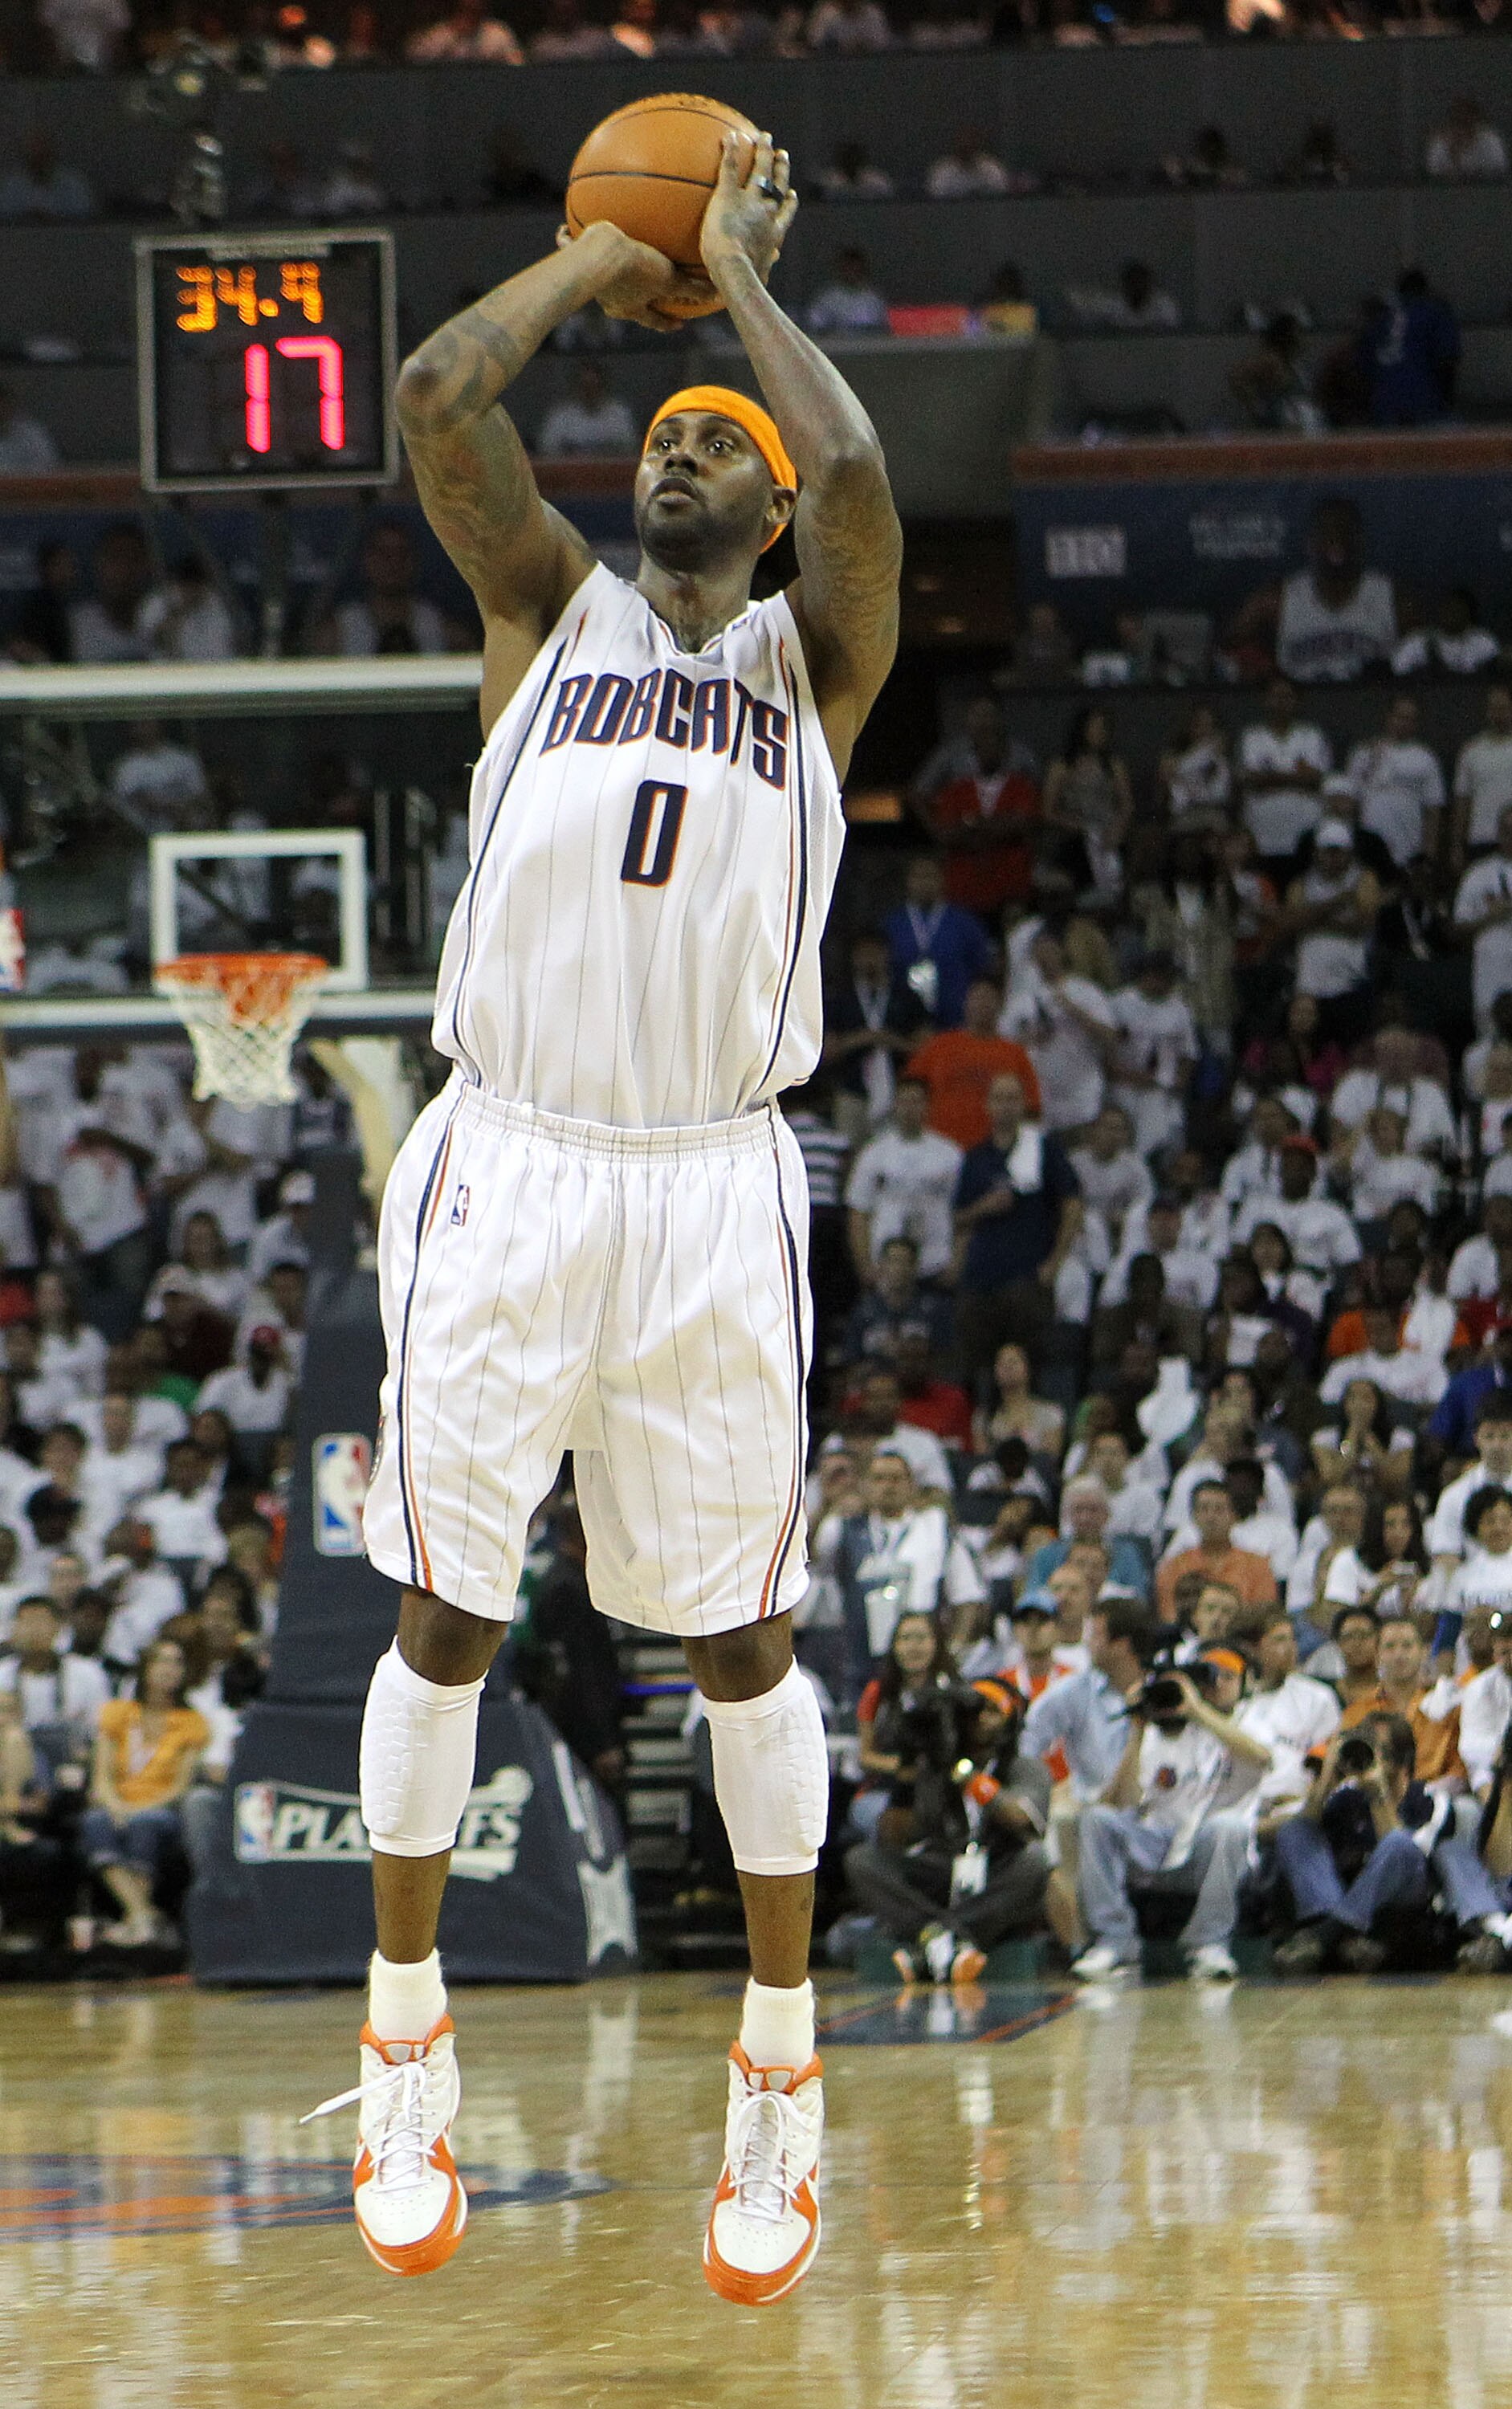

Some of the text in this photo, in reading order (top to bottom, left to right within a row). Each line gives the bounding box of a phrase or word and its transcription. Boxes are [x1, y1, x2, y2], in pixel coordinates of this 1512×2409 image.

[176, 261, 324, 332] 34.9
[244, 335, 345, 454] 17
[538, 667, 790, 792] BOBCATS
[620, 779, 689, 888] 0
[272, 1801, 522, 1849] PLAFS
